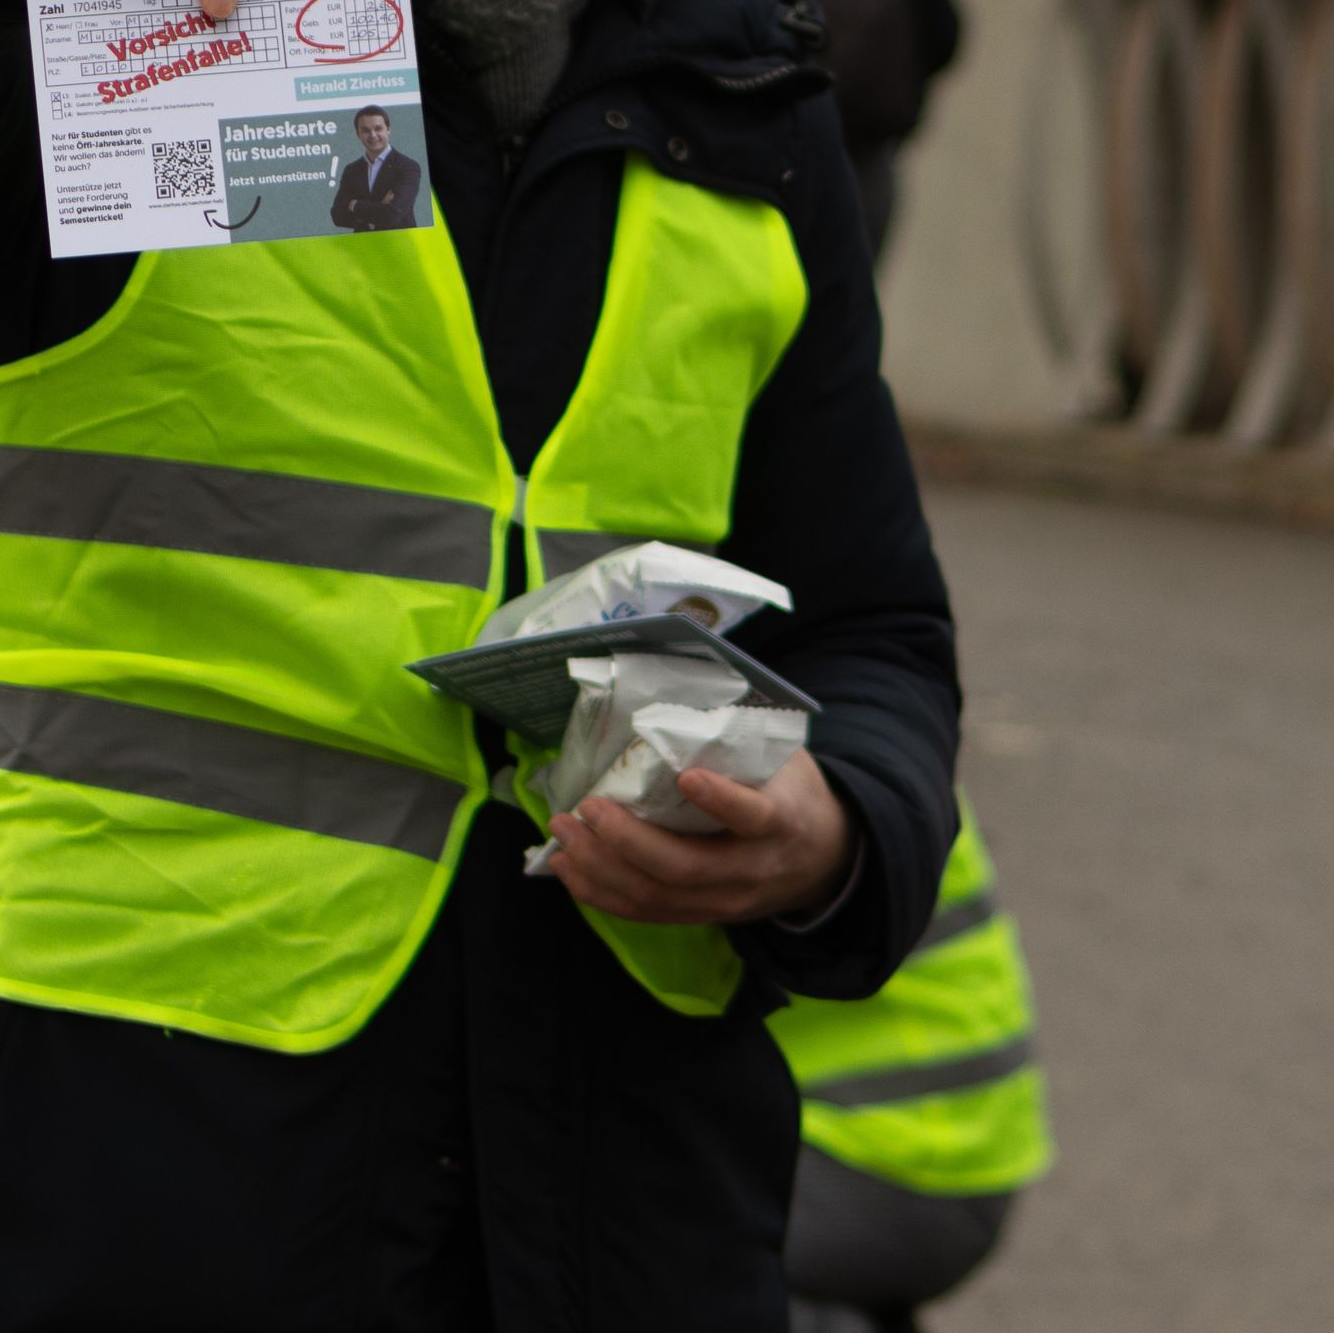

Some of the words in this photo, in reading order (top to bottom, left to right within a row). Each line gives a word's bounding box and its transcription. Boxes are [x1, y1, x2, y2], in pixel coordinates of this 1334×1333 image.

[39, 4, 65, 15] Zahl
[73, 0, 123, 13] 17041945
[327, 2, 342, 12] EUR
[328, 17, 344, 26] EUR
[107, 11, 217, 61] Vorsicht
[330, 31, 345, 40] EUR
[98, 31, 252, 104] Strafenfalle!
[300, 80, 348, 94] Harald
[350, 74, 406, 90] Zierfuss
[51, 133, 67, 141] Nur
[67, 130, 79, 140] für
[81, 127, 124, 139] Studenten
[124, 126, 142, 137] gibt
[142, 126, 153, 134] es
[224, 119, 339, 144] Jahreskarte
[53, 143, 75, 152] keine
[224, 147, 248, 163] für
[250, 142, 332, 162] Studenten
[54, 153, 68, 163] Wir
[70, 150, 97, 161] wollen
[98, 148, 114, 158] das
[55, 164, 66, 173] Du
[67, 162, 92, 172] auch?
[258, 168, 327, 185] unterstützen
[57, 183, 103, 194] Unterstütze
[103, 181, 123, 192] jetzt
[58, 195, 85, 205] unsere
[86, 192, 129, 203] Forderung
[58, 205, 75, 215] und
[76, 203, 113, 216] gewinne
[113, 201, 132, 212] dein
[59, 212, 124, 226] Semesterticket!
